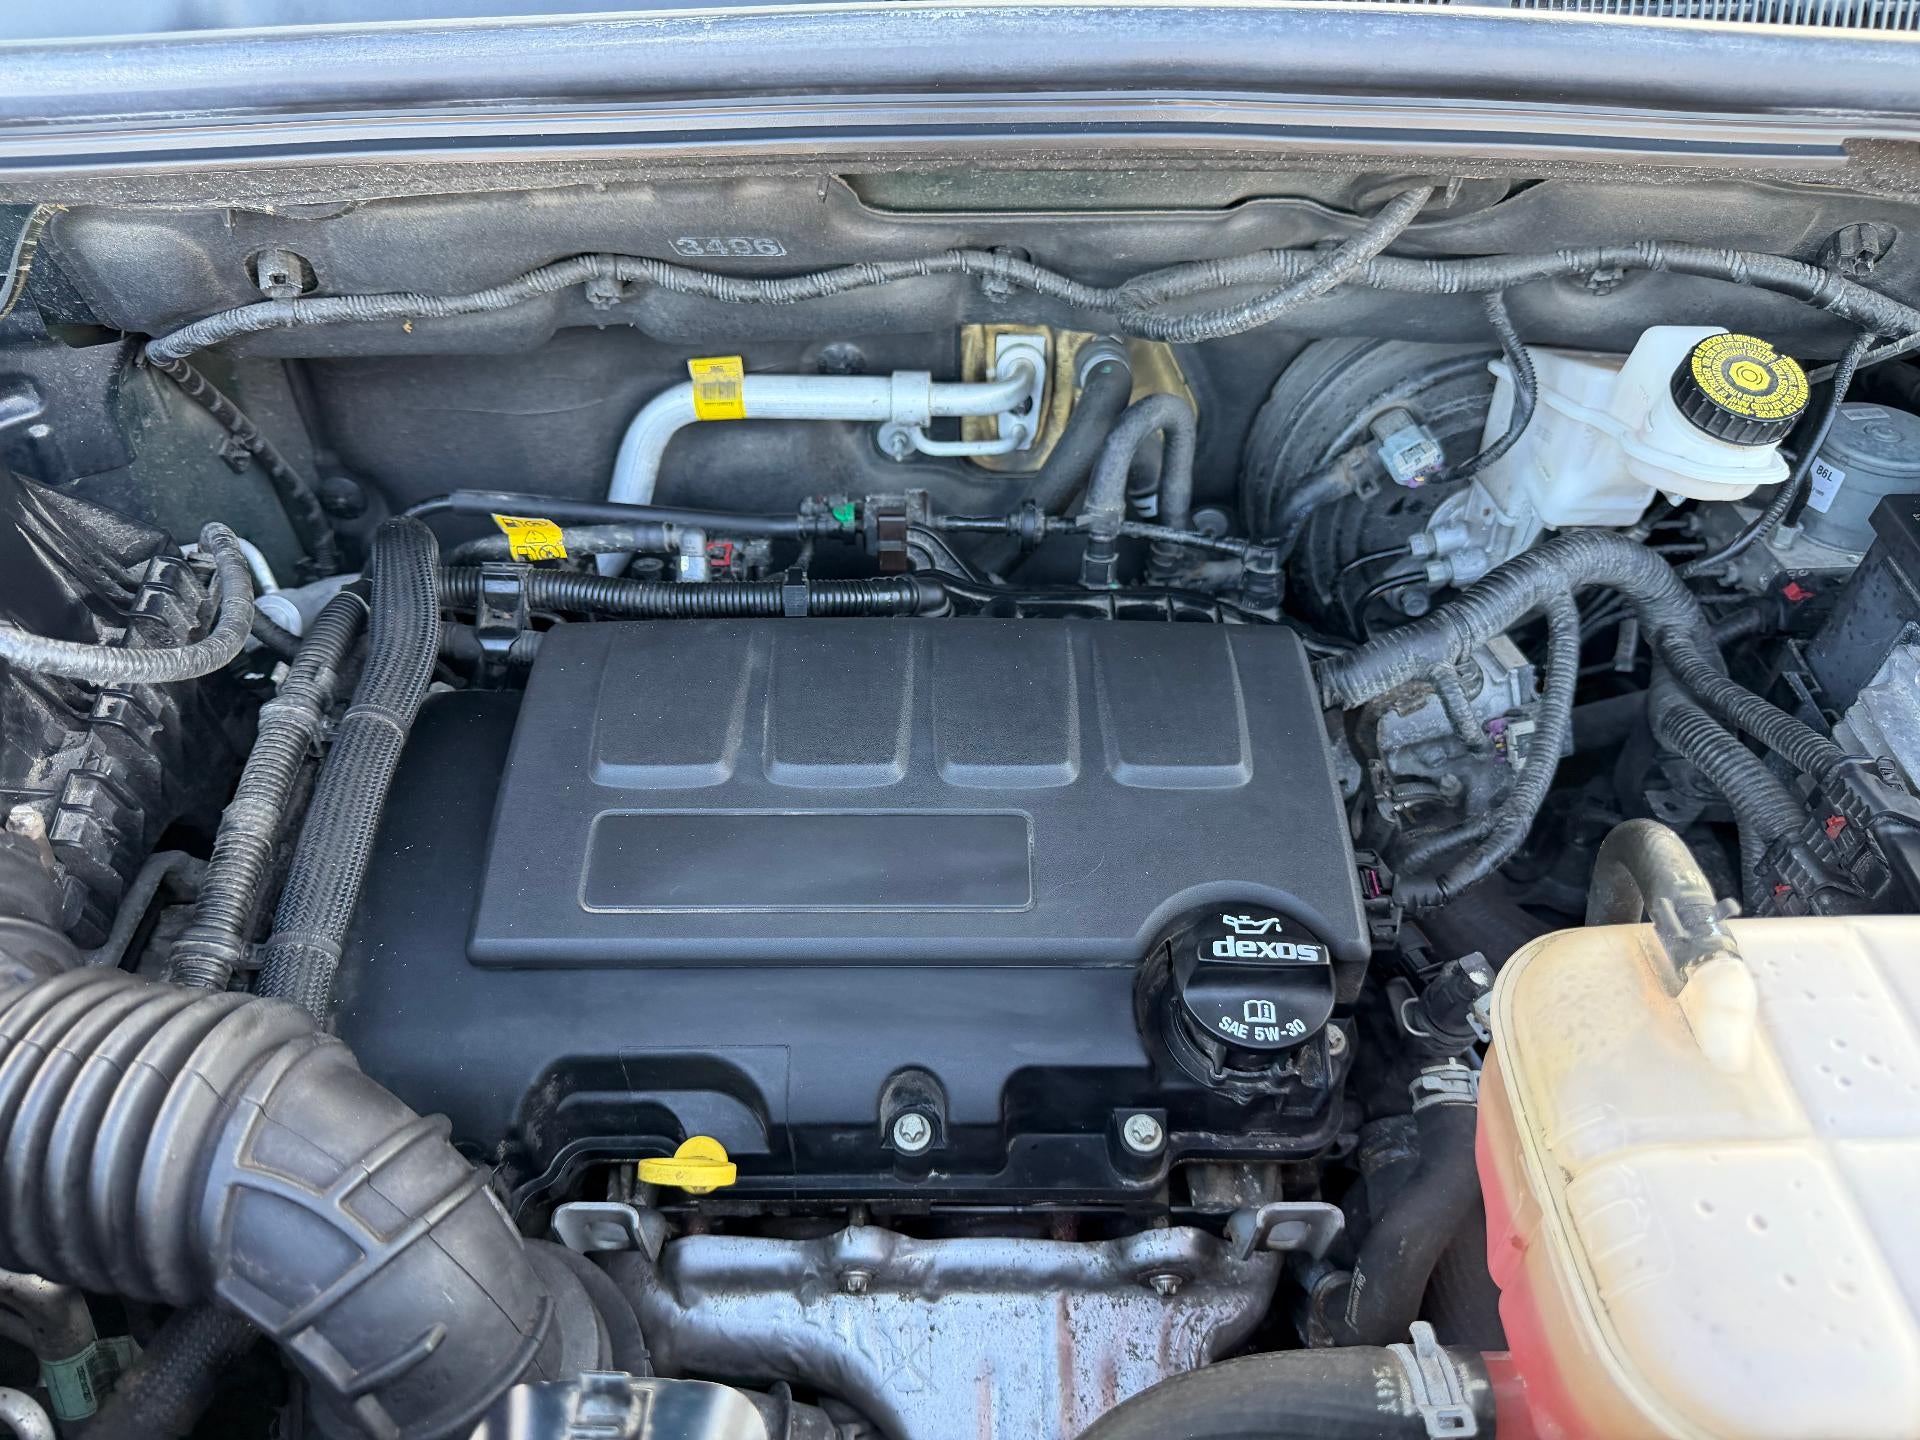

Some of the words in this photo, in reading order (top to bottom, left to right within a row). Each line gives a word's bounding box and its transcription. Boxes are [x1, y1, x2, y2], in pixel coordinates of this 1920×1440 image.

[1816, 465, 1832, 481] B6L
[1213, 936, 1319, 961] dexos
[1219, 1016, 1249, 1039] SAE
[1254, 1018, 1307, 1041] 5W-30
